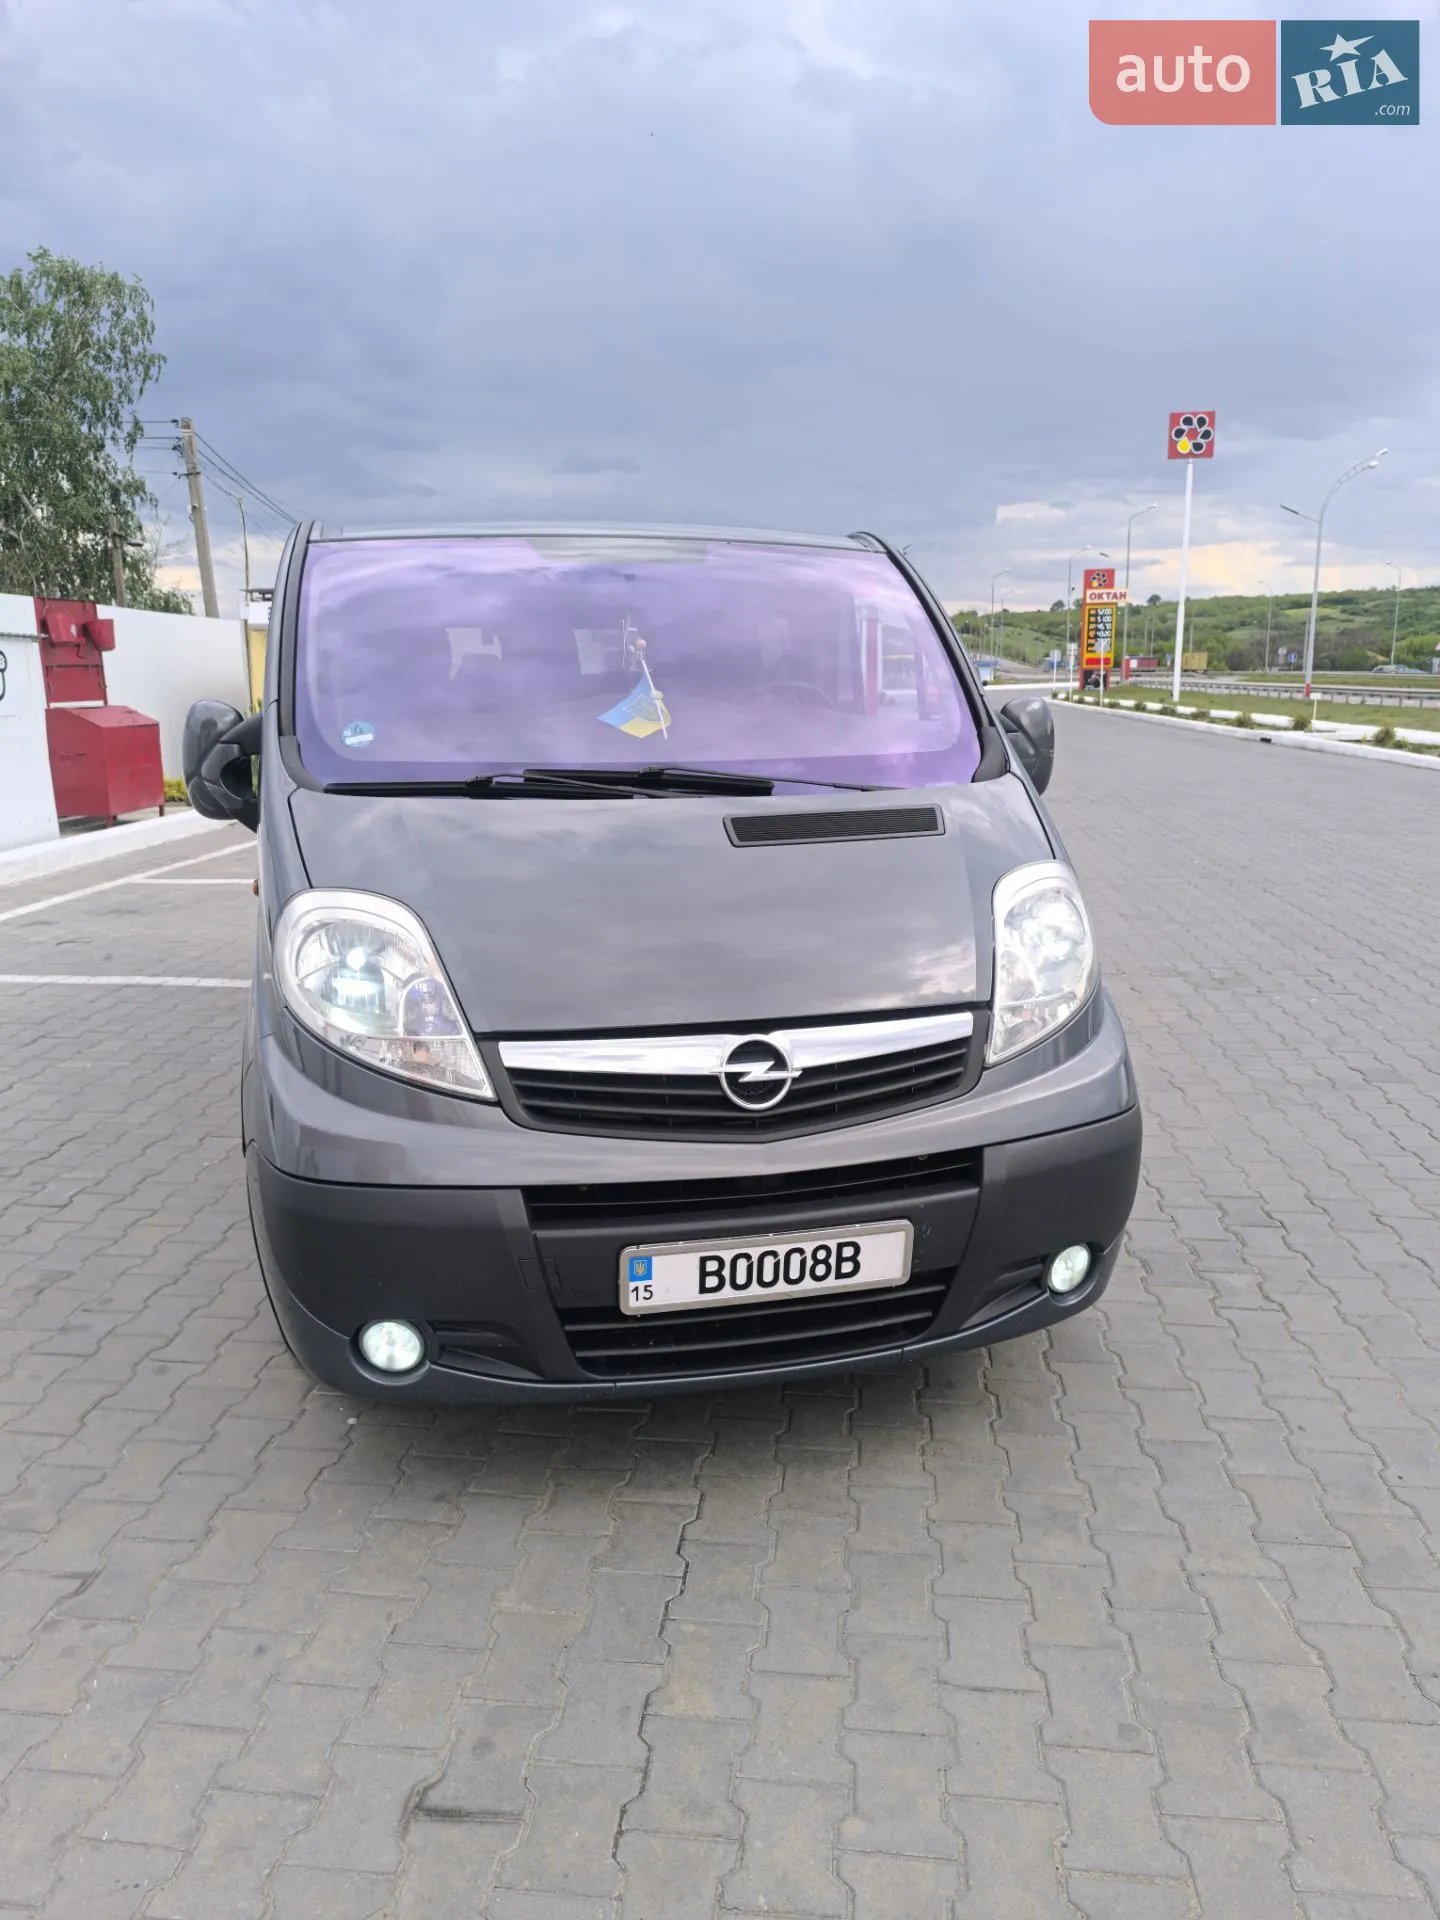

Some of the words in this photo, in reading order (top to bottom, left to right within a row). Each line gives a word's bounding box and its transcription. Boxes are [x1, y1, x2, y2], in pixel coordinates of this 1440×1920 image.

[1089, 591, 1127, 601] ОКТАН
[698, 1240, 862, 1295] B0008B
[631, 1284, 654, 1302] 15
